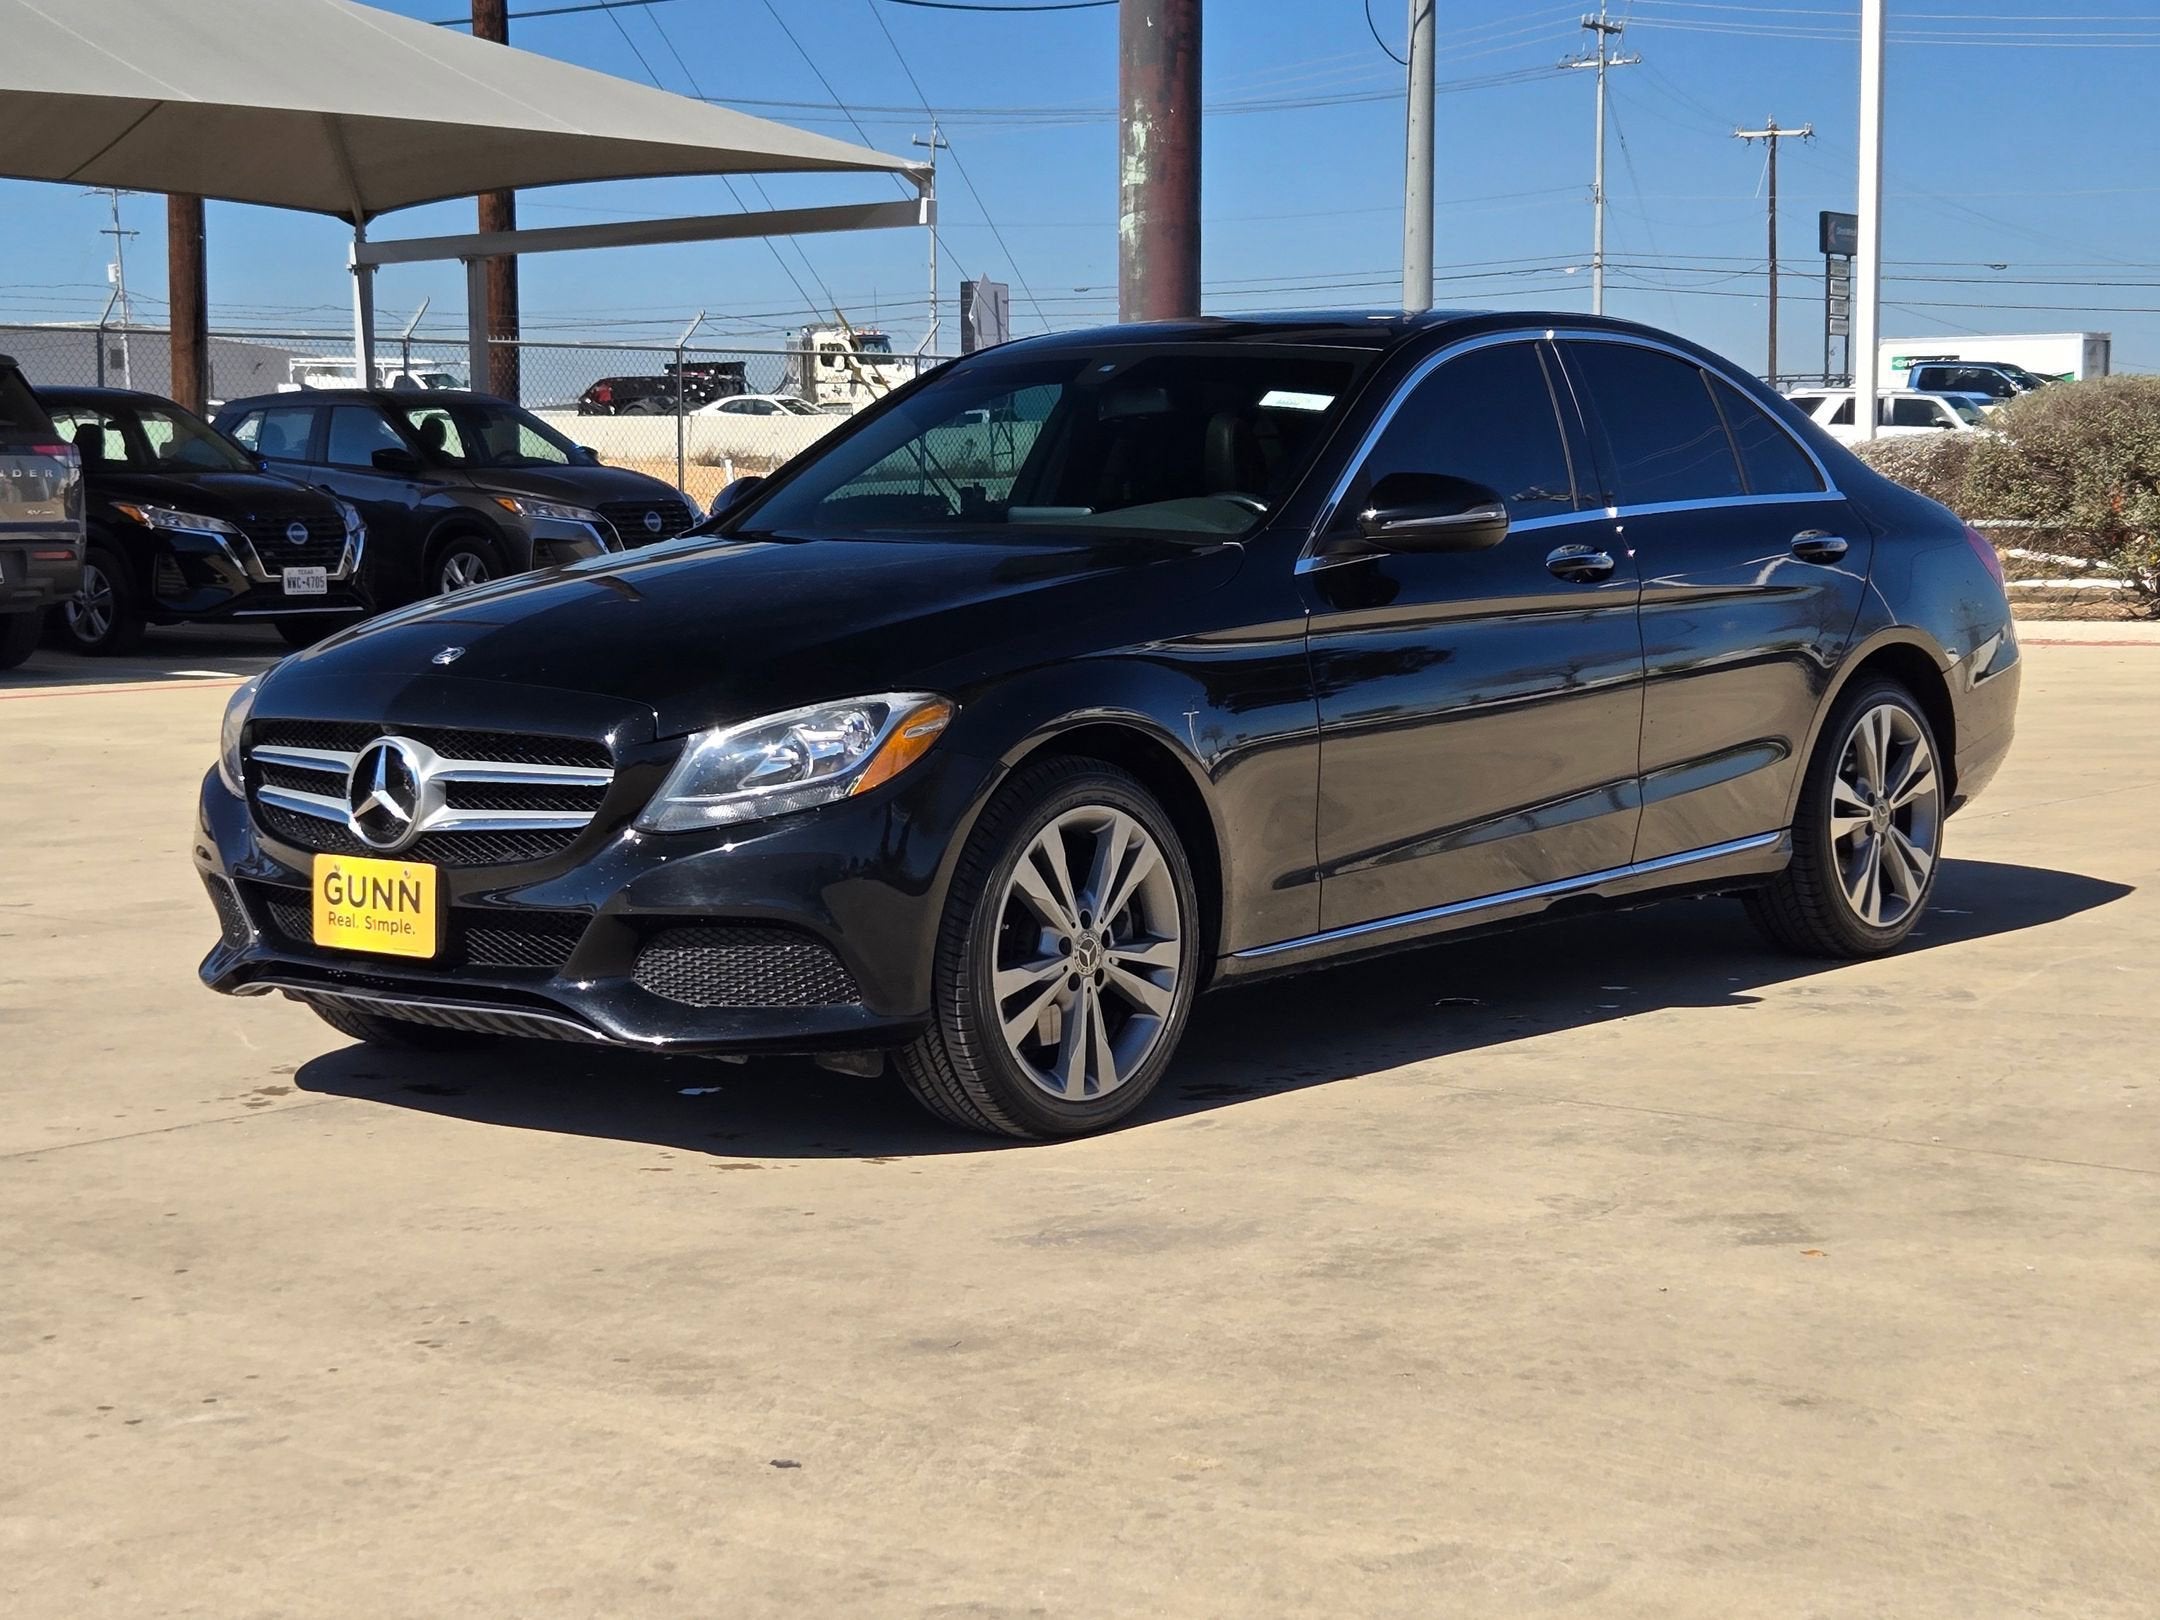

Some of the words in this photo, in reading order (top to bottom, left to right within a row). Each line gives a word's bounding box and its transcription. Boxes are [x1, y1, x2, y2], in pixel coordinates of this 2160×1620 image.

[324, 872, 420, 914] GUNN
[328, 911, 360, 929] Real.
[364, 916, 416, 936] Simple.
